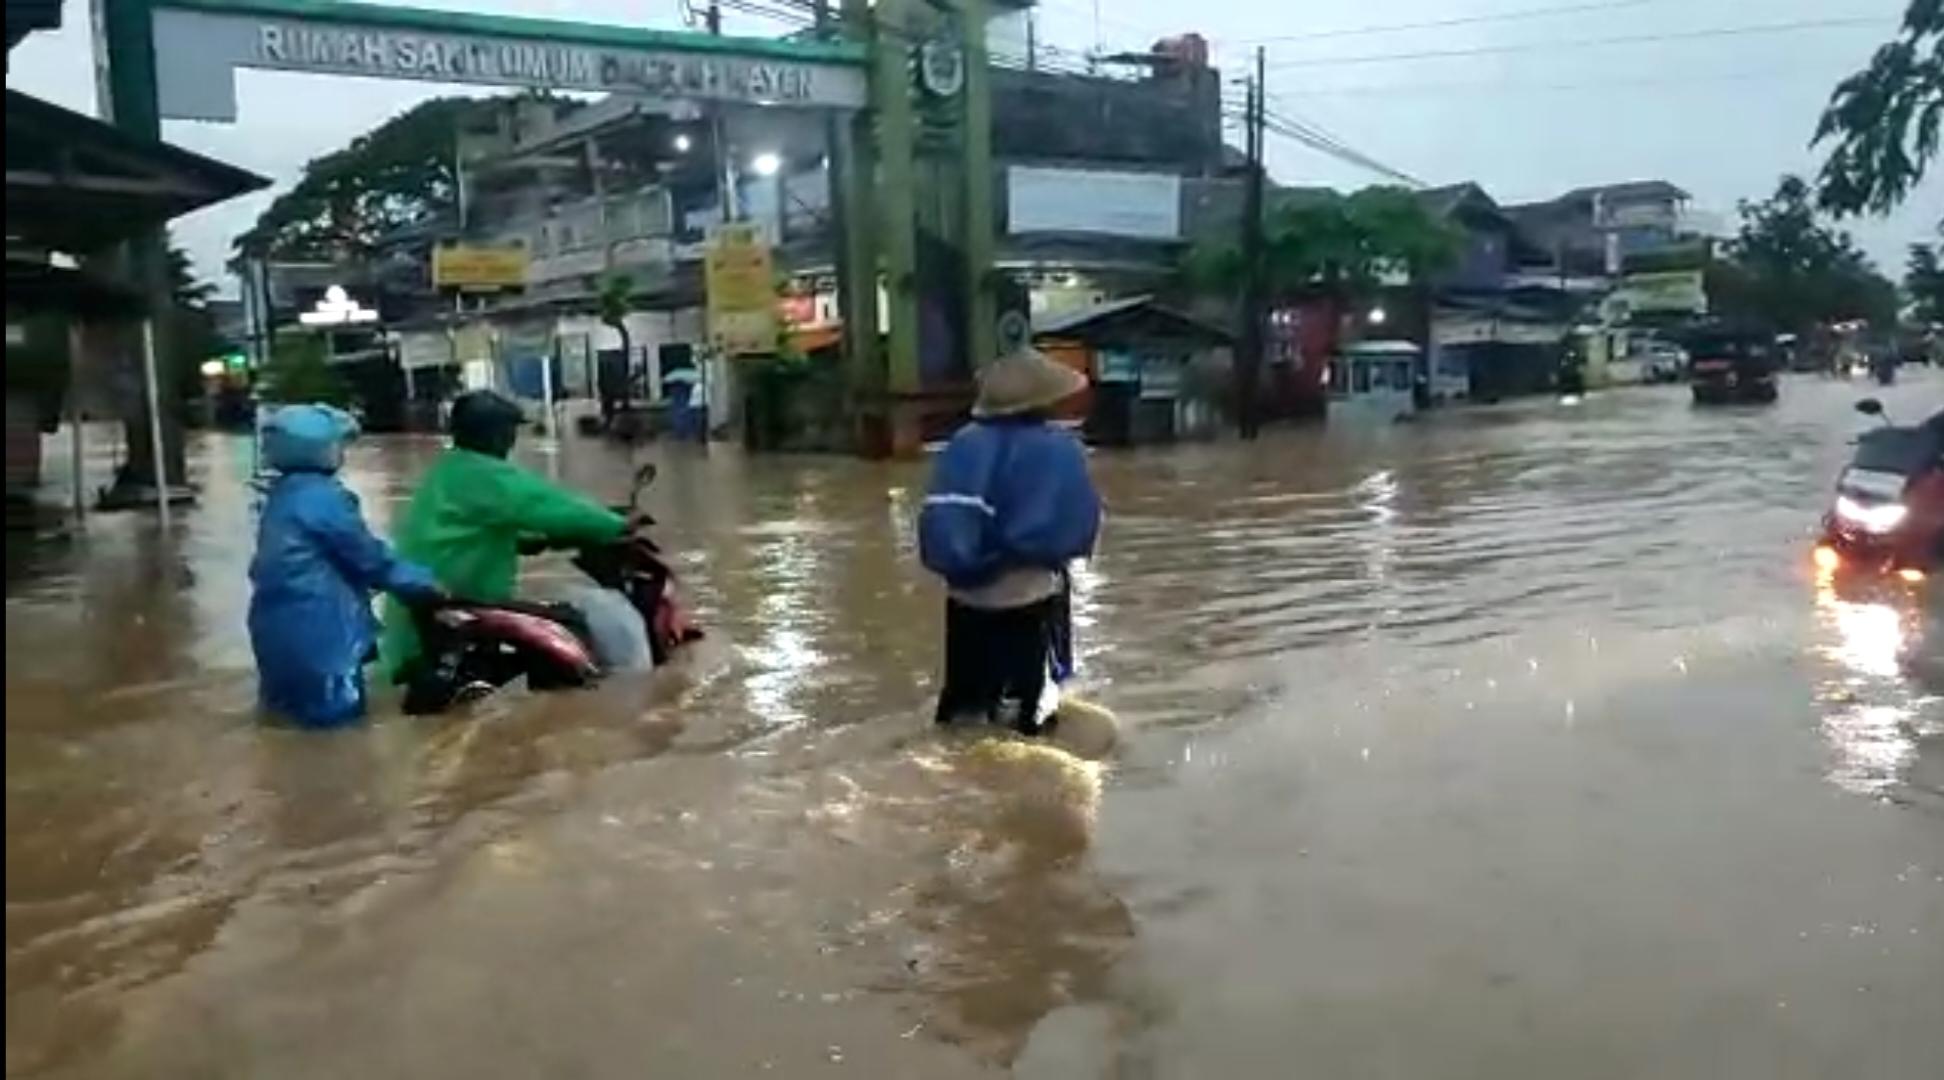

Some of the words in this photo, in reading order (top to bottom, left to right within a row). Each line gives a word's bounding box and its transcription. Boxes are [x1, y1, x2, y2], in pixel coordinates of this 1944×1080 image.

[258, 23, 387, 63] RUMAH
[397, 37, 488, 74] SAKIT
[501, 43, 594, 84] UMUM
